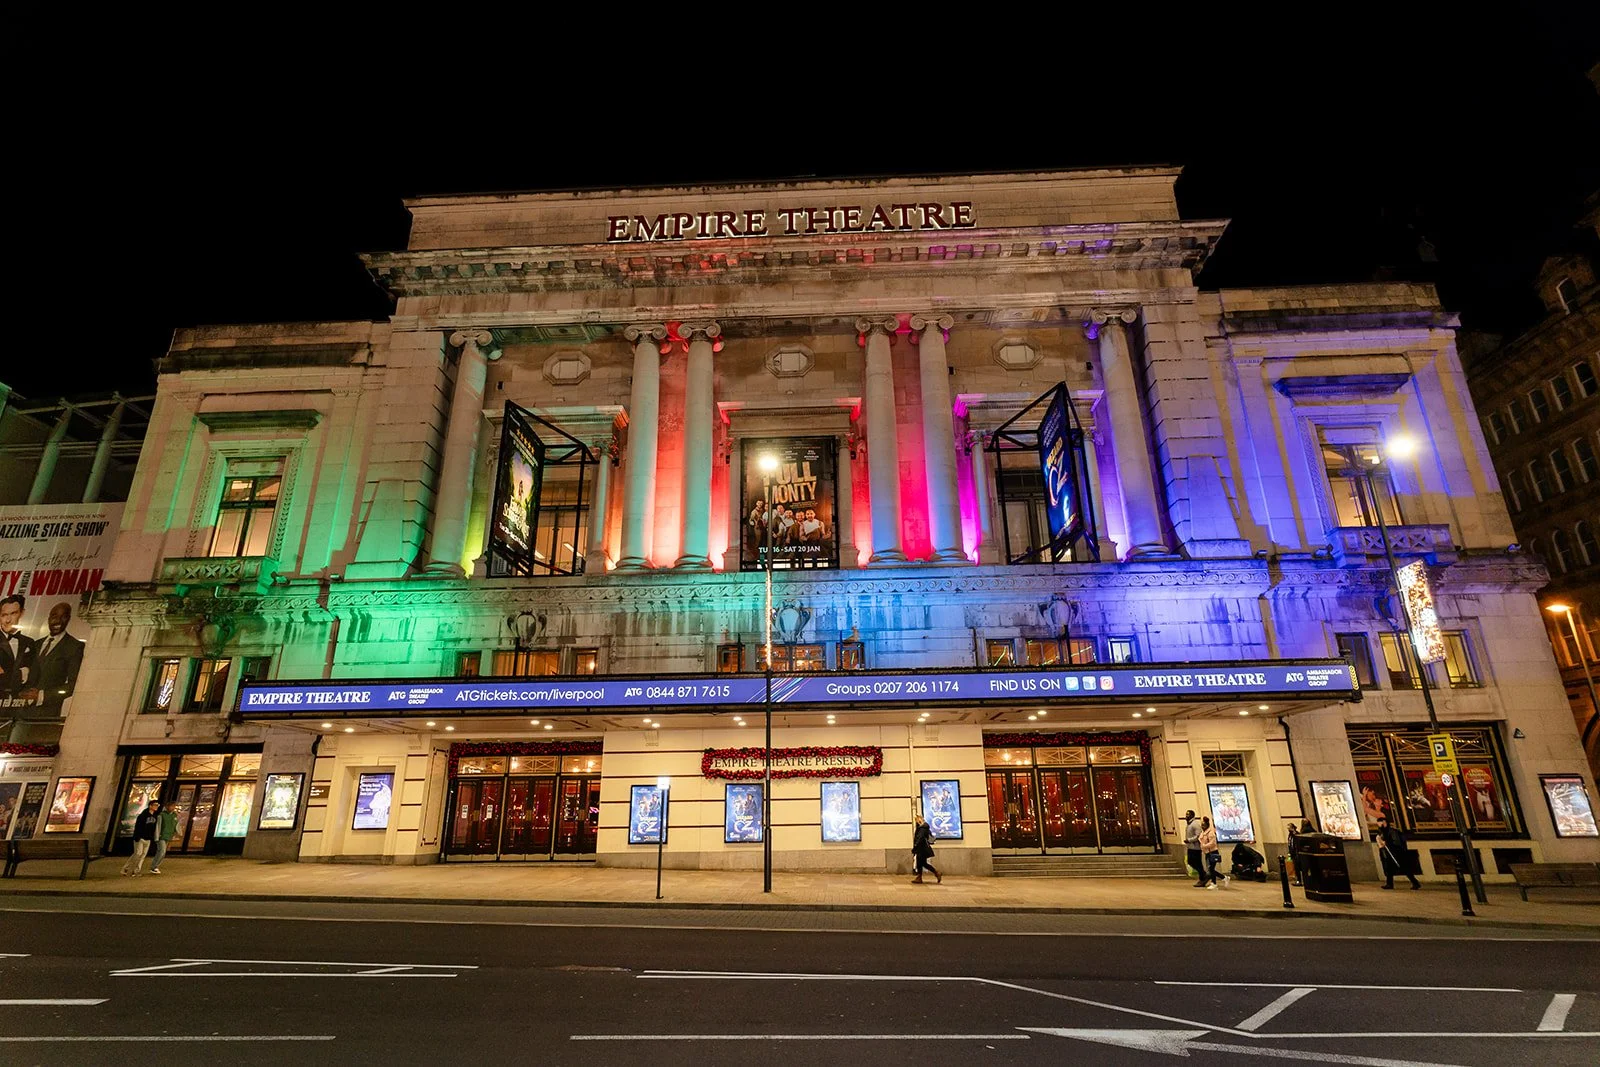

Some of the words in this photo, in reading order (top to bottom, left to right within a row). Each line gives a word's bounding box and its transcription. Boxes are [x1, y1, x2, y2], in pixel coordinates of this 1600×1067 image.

[607, 209, 768, 242] EMPIRE
[778, 202, 976, 236] THEATRE
[0, 523, 40, 539] AZZLING
[41, 522, 74, 537] STAGE
[74, 521, 110, 536] SHOW'
[30, 568, 104, 596] WOMAN
[990, 679, 1018, 691] FIND
[1022, 679, 1038, 691] US
[1041, 678, 1061, 690] ON
[1134, 675, 1194, 688] EMPIRE
[1195, 674, 1266, 687] THEATRE
[1285, 672, 1304, 683] ATG
[388, 691, 406, 701] ATG
[455, 688, 604, 704] ATGtickets.com/liverpool
[624, 688, 642, 697] ATG
[646, 686, 675, 698] 0844
[677, 686, 698, 698] 871
[701, 685, 730, 697] 7615
[826, 683, 871, 697] Groups
[874, 682, 903, 694] 0207
[905, 682, 928, 693] 206
[931, 681, 960, 692] 1174
[248, 692, 303, 705] EMPIRE
[305, 690, 371, 704] THEATRE
[1434, 743, 1444, 756] P
[714, 758, 757, 768] EMPIRE
[815, 756, 871, 766] PRESENTS
